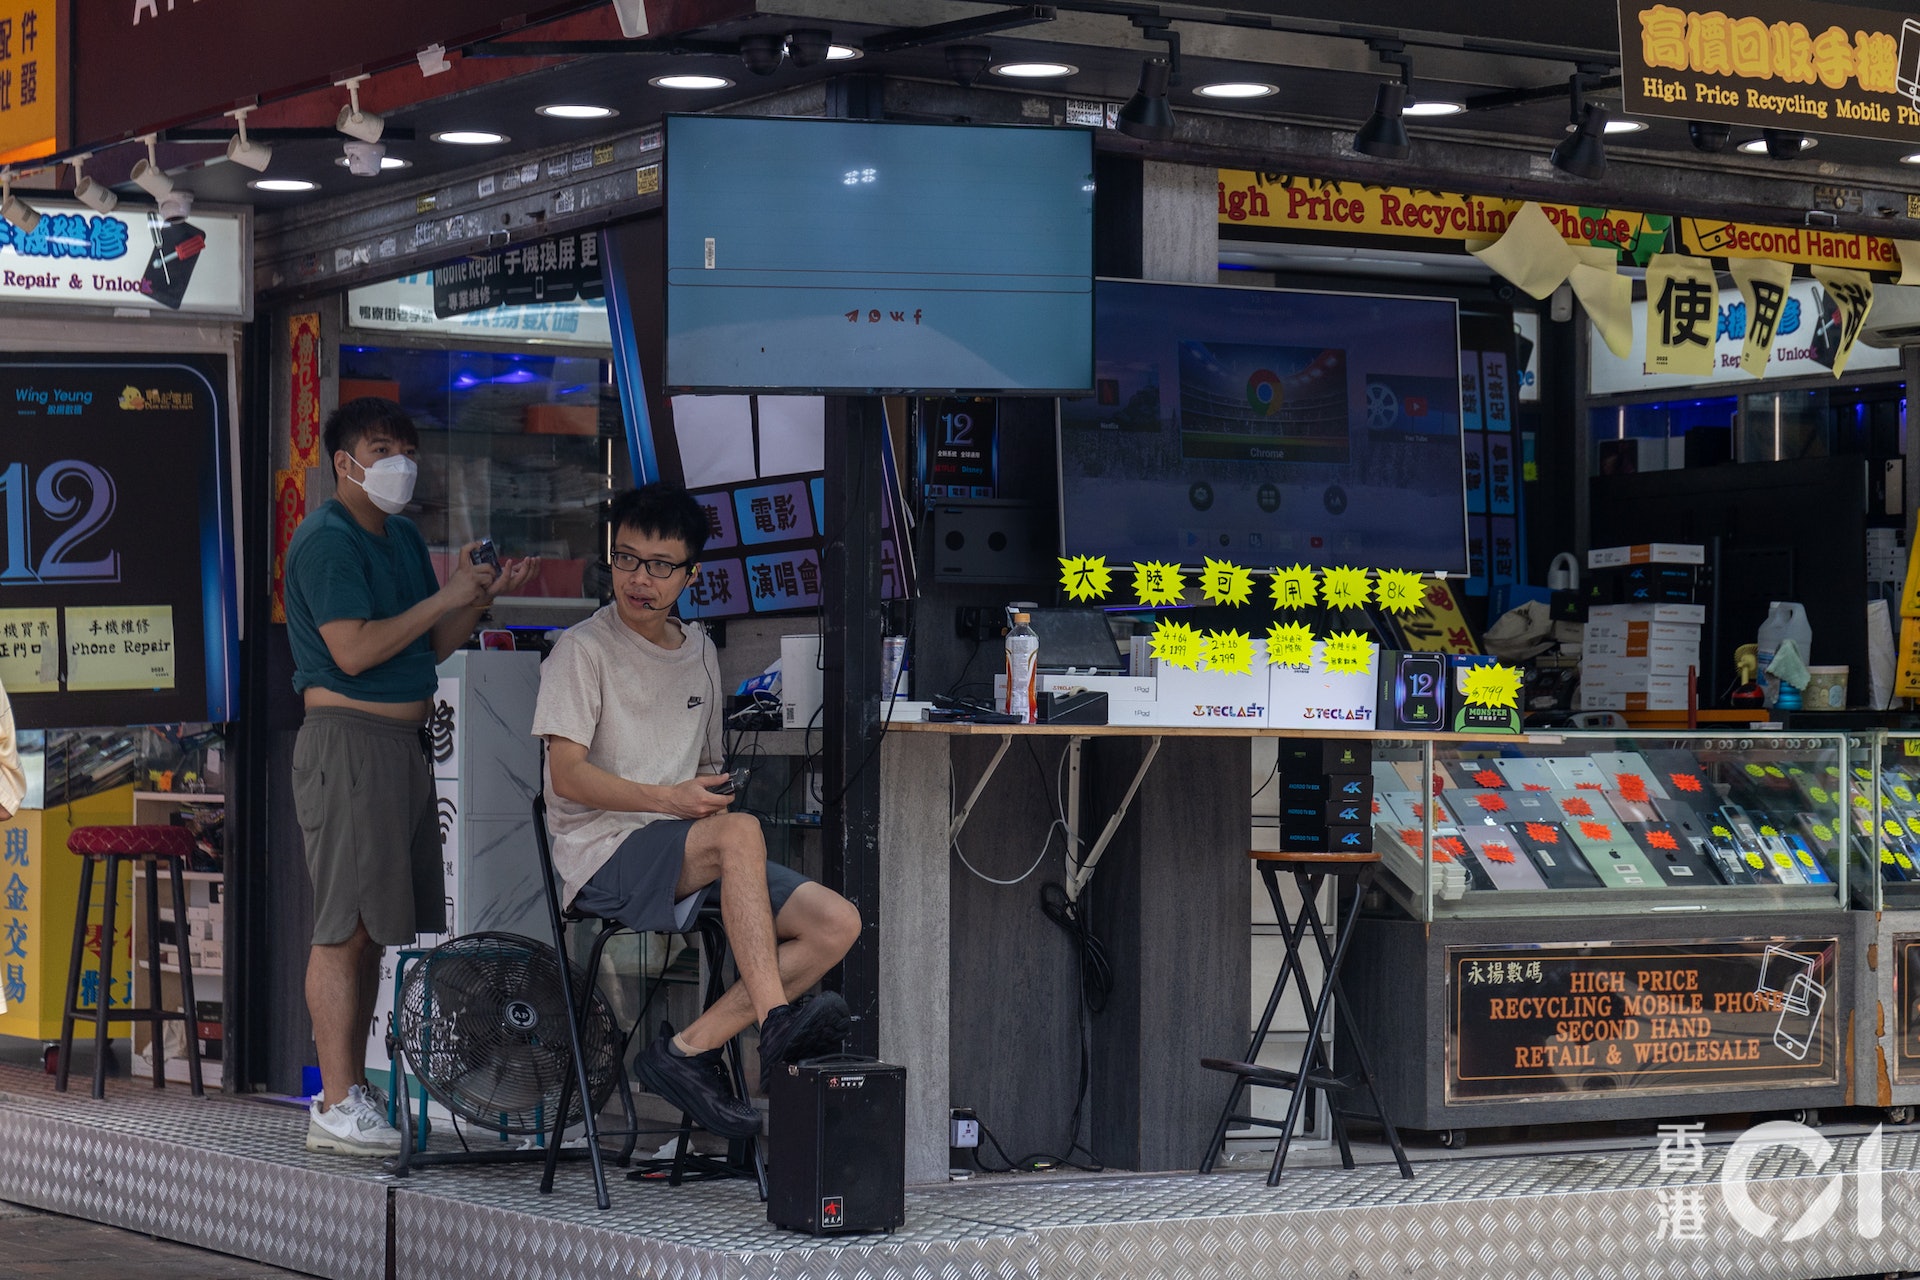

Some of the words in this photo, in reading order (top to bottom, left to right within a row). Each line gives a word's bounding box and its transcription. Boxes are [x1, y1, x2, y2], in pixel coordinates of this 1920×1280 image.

[1639, 4, 1897, 94] 高價回收手機
[1642, 77, 1688, 102] High
[1695, 83, 1739, 107] Price
[1747, 88, 1828, 119] Recycling
[1836, 98, 1891, 123] Mobile
[1218, 182, 1270, 221] igh
[1287, 187, 1365, 223] Price
[0, 213, 129, 261] 機維修
[1725, 222, 1801, 255] Second
[1806, 225, 1863, 259] Hand
[504, 238, 576, 277] 手機換屏
[4, 270, 60, 290] Repair
[69, 274, 83, 289] &
[15, 387, 49, 404] Wing
[53, 388, 93, 404] Yeung
[941, 412, 976, 446] 12
[1249, 447, 1285, 460] Chrome
[0, 459, 121, 586] 12
[751, 492, 798, 532] 電影
[751, 557, 819, 599] 演唱會
[1073, 560, 1097, 590] 大
[1334, 581, 1351, 598] 4K
[88, 618, 151, 636] 手機維修
[71, 643, 116, 656] Phone
[124, 639, 171, 654] Repair
[1409, 673, 1434, 698] 12
[1472, 686, 1504, 701] $799
[1205, 702, 1265, 719] TECLAST
[1315, 706, 1373, 721] TECLAST
[1468, 708, 1508, 716] MONSTER
[1343, 782, 1362, 794] 4K
[1339, 808, 1359, 820] 4K
[1341, 833, 1360, 845] 4K
[3, 827, 30, 1005] 現金交易
[1467, 960, 1544, 986] 永揚數碼
[1570, 971, 1626, 994] HIGH
[1637, 969, 1699, 992] PRICE
[1489, 996, 1612, 1020] RECYCLING
[1622, 994, 1703, 1017] MOBILE
[1713, 991, 1785, 1014] PHONE
[1555, 1020, 1640, 1042] SECOND
[1651, 1017, 1712, 1039] HAND
[1514, 1045, 1595, 1068] RETAIL
[1606, 1045, 1622, 1065] &
[1634, 1038, 1761, 1064] WHOLESALE
